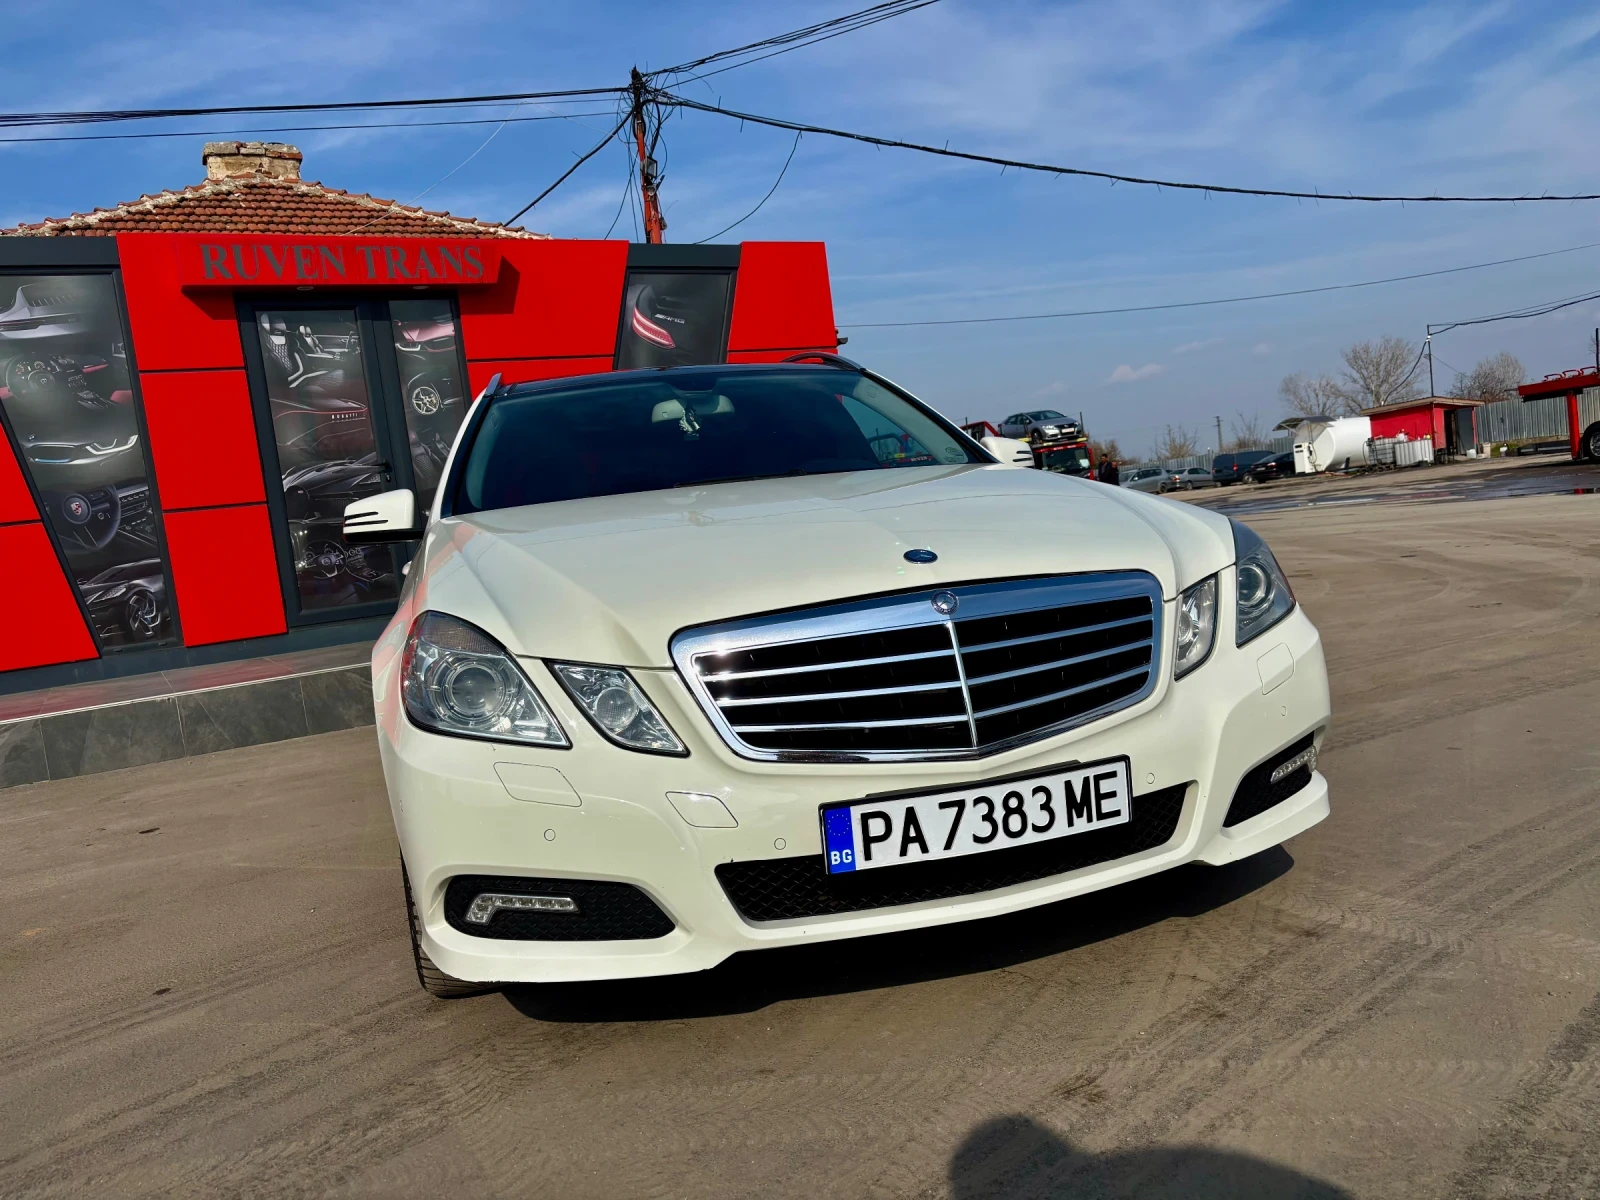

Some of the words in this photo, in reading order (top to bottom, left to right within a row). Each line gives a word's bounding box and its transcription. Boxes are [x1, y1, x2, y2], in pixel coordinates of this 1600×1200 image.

[198, 244, 347, 279] RUVEN
[355, 245, 484, 280] TRANS
[860, 806, 929, 861] PA
[938, 785, 1056, 850] 7383
[1064, 770, 1122, 828] ME
[830, 849, 853, 865] BG
